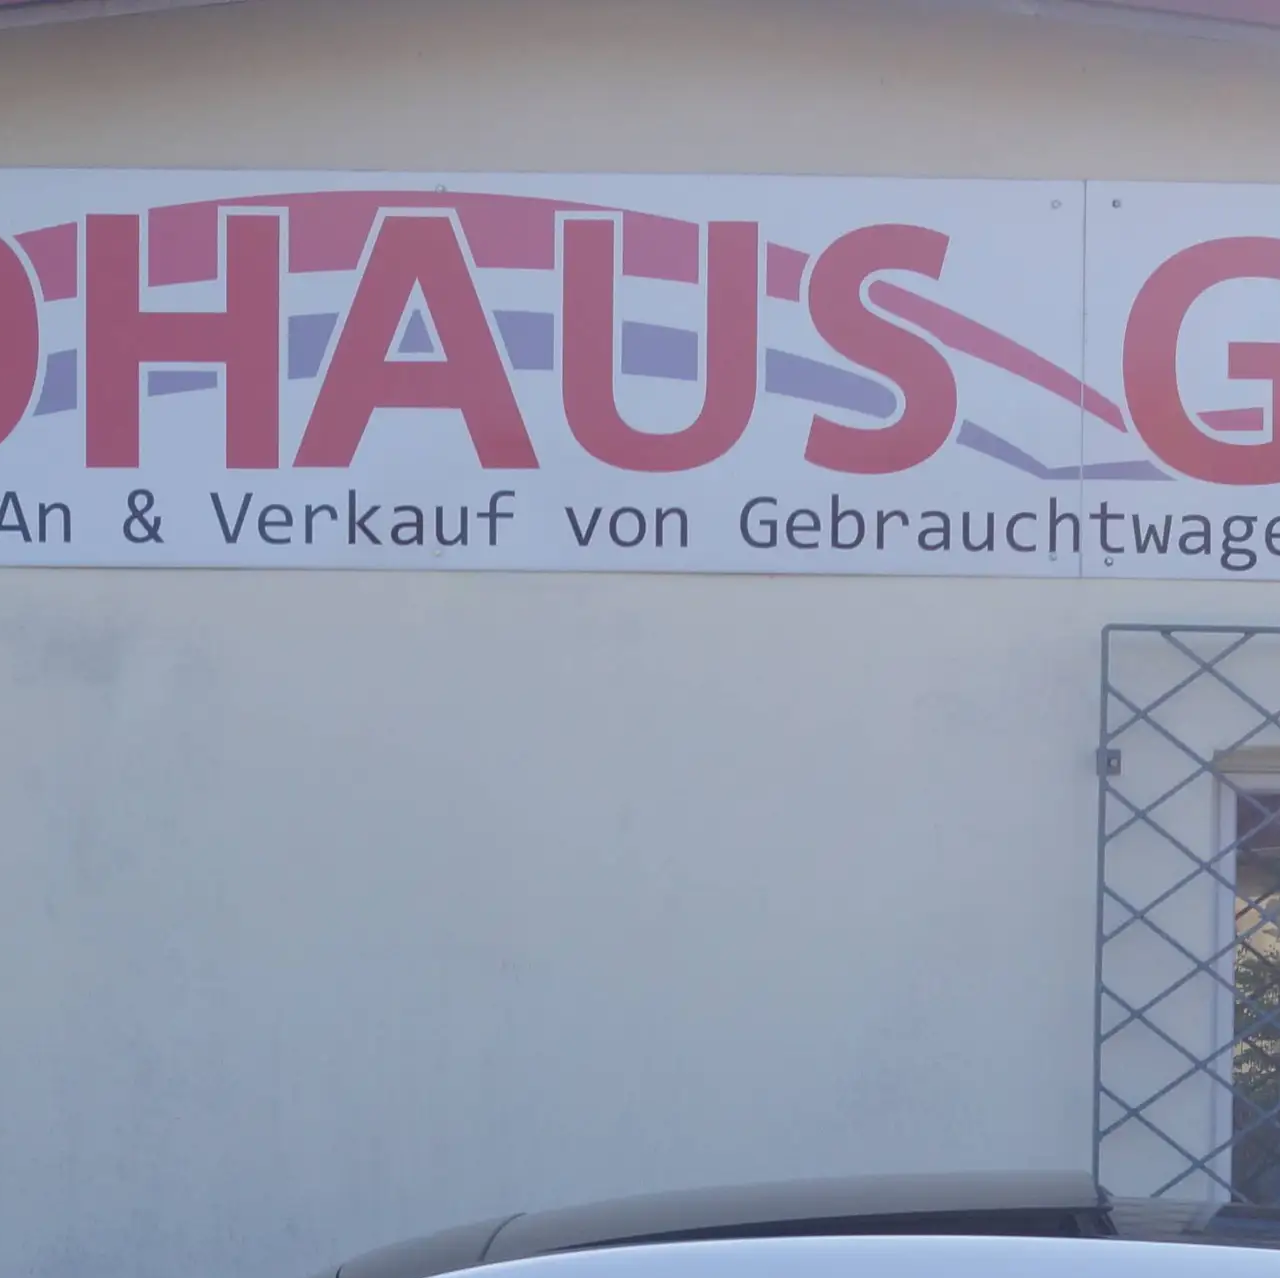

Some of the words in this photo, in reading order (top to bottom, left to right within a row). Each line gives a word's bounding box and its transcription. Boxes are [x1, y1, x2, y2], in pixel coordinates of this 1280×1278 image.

[122, 488, 164, 545] &
[209, 490, 517, 547] Verkauf
[565, 506, 690, 549] von
